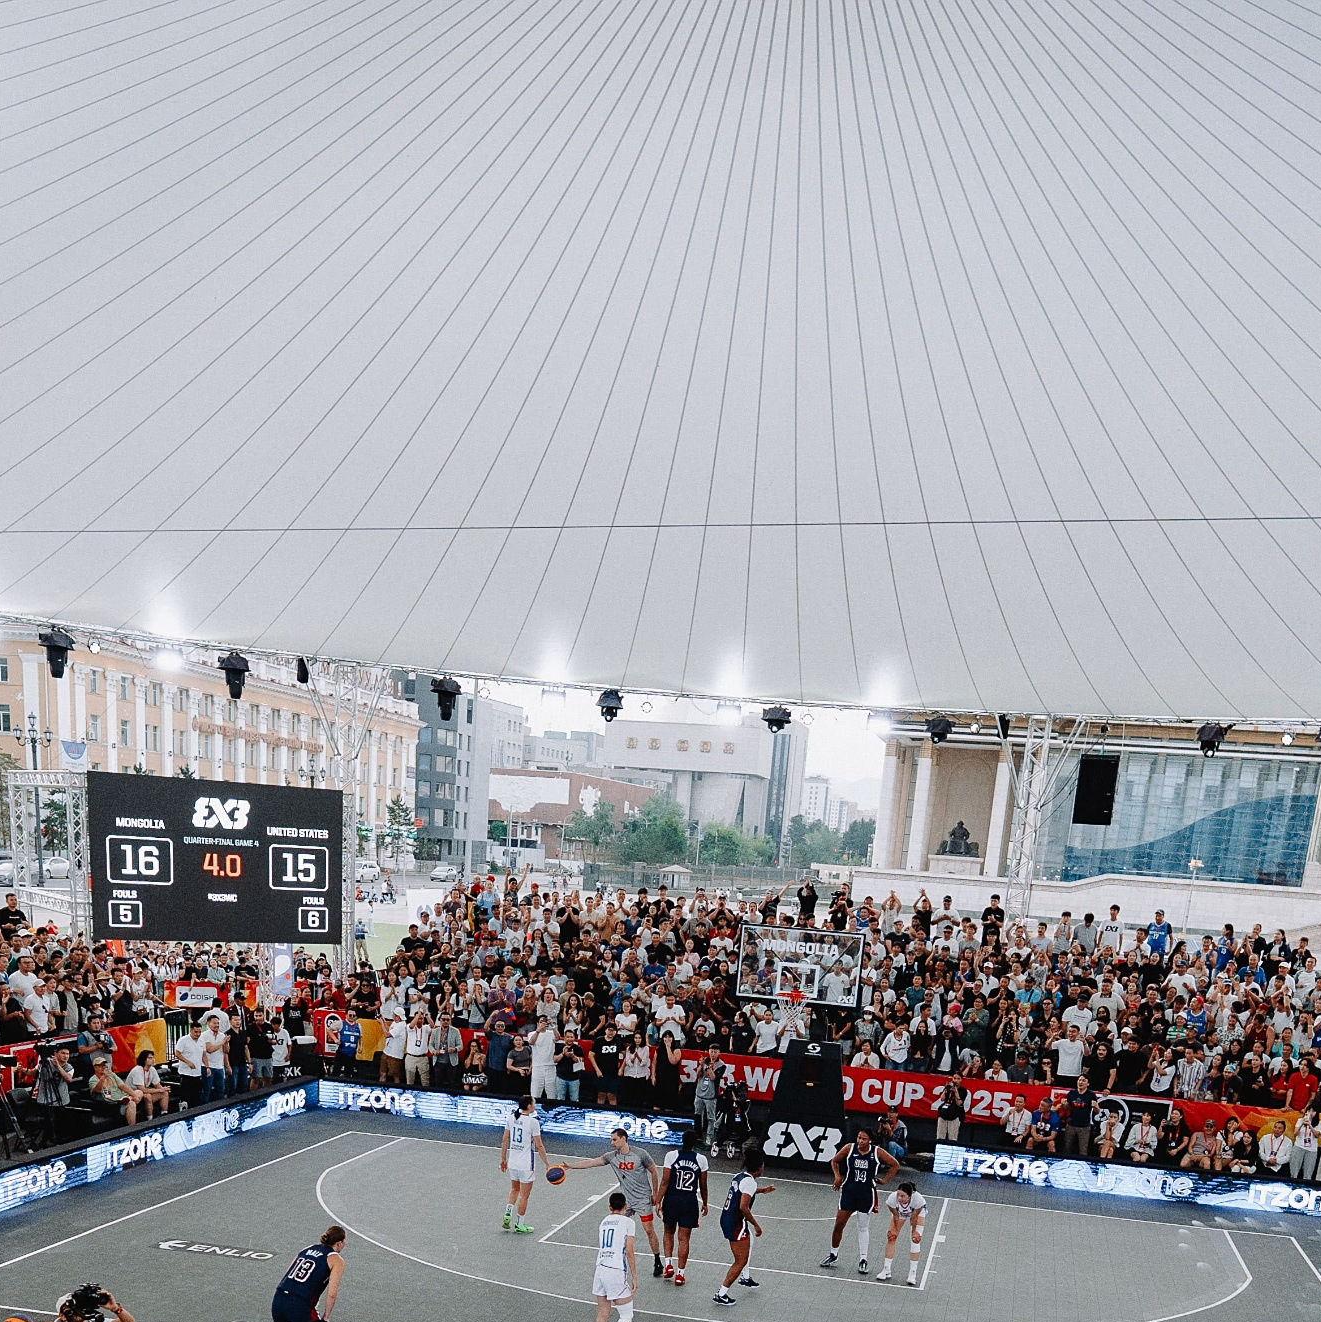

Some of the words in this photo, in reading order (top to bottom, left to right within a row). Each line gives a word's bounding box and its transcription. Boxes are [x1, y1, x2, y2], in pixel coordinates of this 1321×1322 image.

[115, 817, 165, 830] MONGOLIA
[266, 826, 297, 838] UNITED
[299, 828, 329, 839] STATES
[183, 836, 233, 847] QUARTER-FINAL
[235, 839, 253, 848] GAME
[254, 840, 260, 848] 4
[120, 844, 160, 876] 16
[202, 853, 242, 877] 4.0
[282, 853, 316, 882] 15
[113, 889, 137, 899] FOULS
[302, 896, 324, 906] FOULS
[119, 904, 132, 923] 5
[307, 911, 320, 928] 6
[761, 938, 839, 958] MONGOLIA
[861, 1079, 925, 1108] CUP
[512, 1126, 523, 1143] 13
[676, 1169, 695, 1191] 12
[854, 1169, 867, 1182] 14
[602, 1228, 615, 1249] 10
[187, 1243, 274, 1260] ENLIO
[287, 1257, 316, 1283] 13
